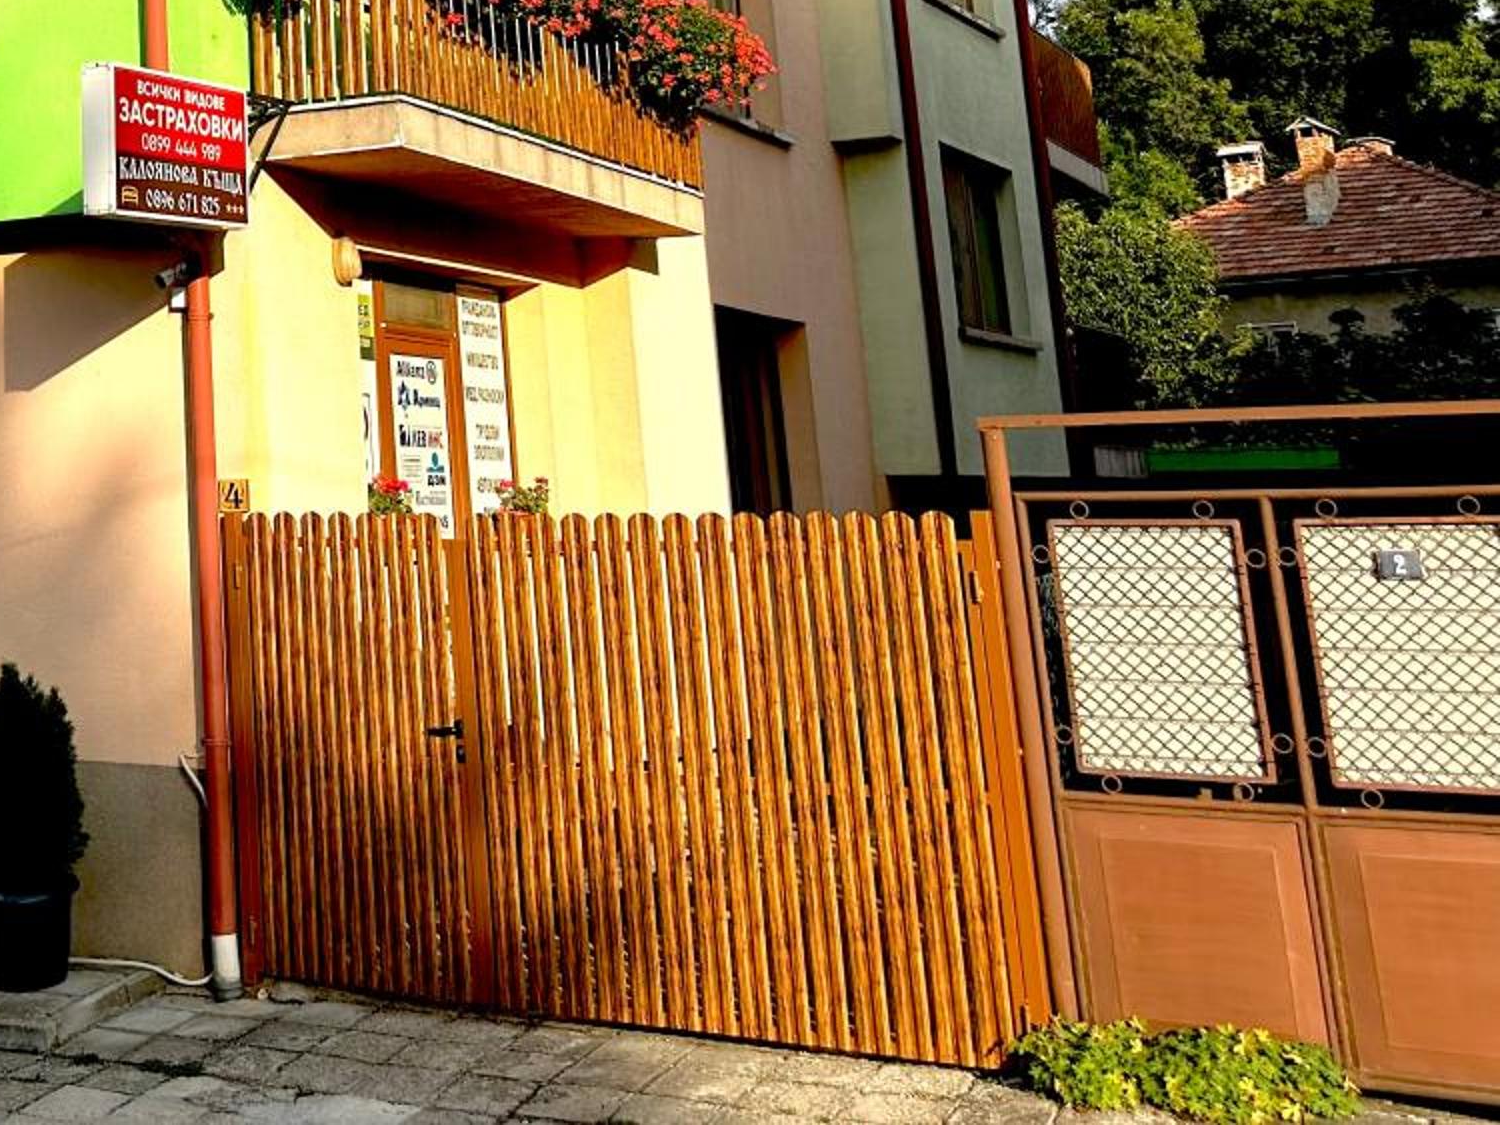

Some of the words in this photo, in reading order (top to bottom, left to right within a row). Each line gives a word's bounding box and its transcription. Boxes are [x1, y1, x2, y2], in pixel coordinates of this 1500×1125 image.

[137, 79, 181, 102] ВСИЧКИ
[183, 88, 225, 112] ВИДОВЕ
[119, 96, 244, 142] ЗАСТРАХОВКИ
[141, 133, 171, 153] 0899
[175, 138, 198, 158] 444
[118, 156, 199, 186] КАЛОЯНОВА
[202, 168, 244, 197] КЪЩА
[179, 192, 199, 215] 671
[224, 482, 244, 510] 4
[1393, 554, 1408, 576] 2
